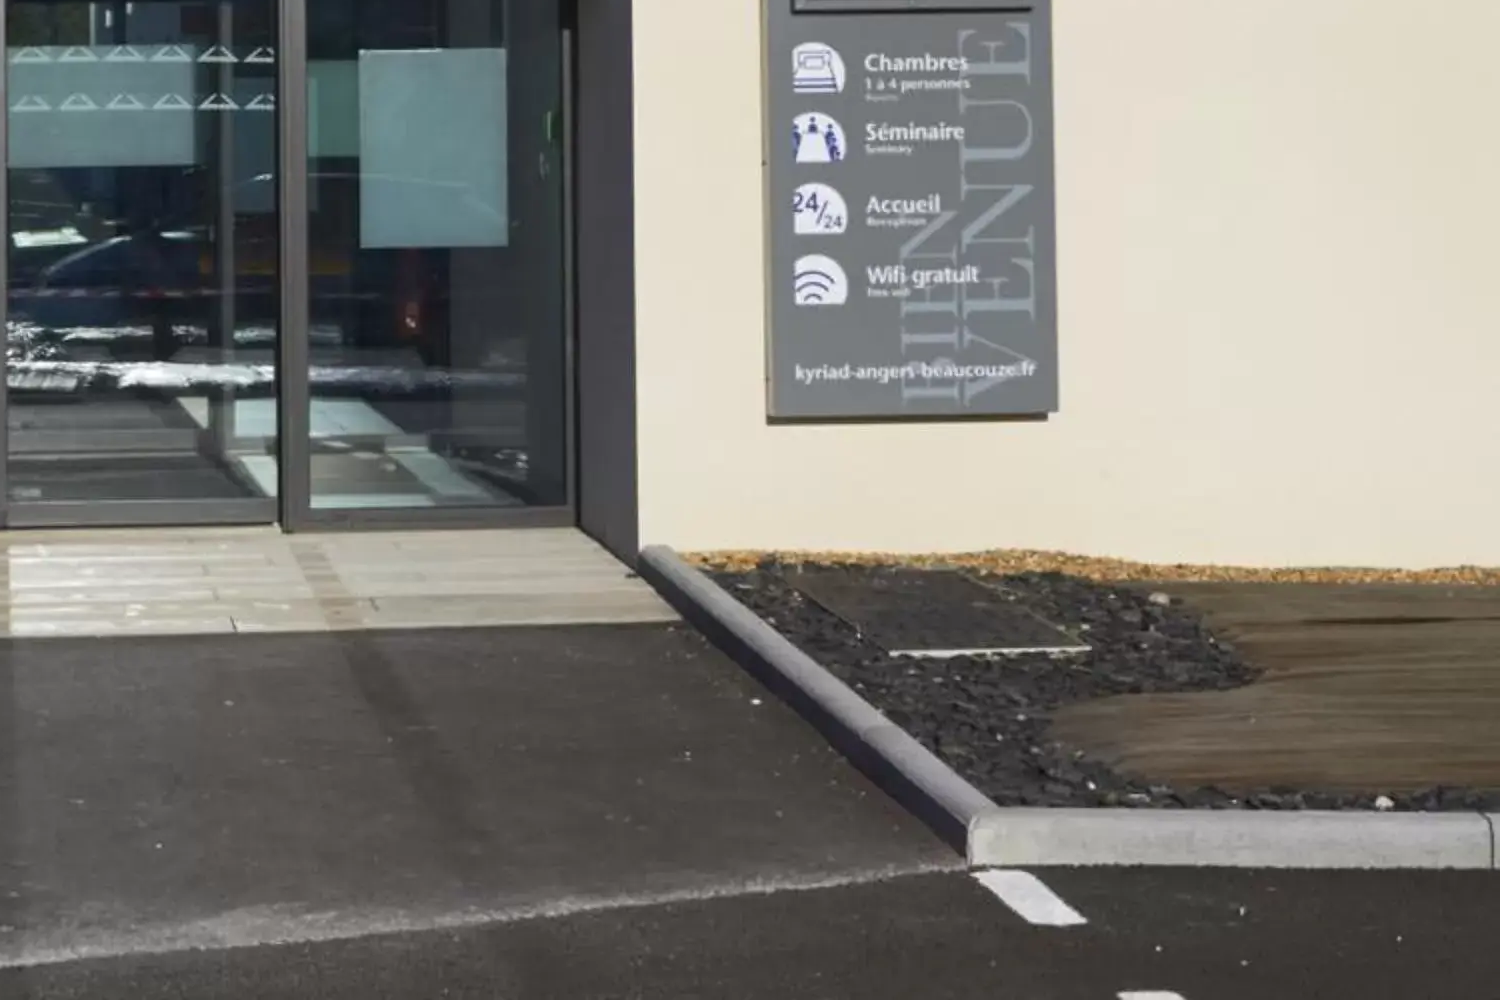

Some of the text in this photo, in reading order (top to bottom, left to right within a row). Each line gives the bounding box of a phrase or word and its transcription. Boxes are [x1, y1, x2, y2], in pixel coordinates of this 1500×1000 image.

[864, 53, 968, 73] Chambres
[865, 78, 872, 90] 1
[887, 78, 898, 90] 4
[900, 77, 971, 95] personnes
[865, 121, 965, 142] Séminaire
[865, 194, 941, 214] Accueil
[866, 264, 979, 289] Wifi gratuit
